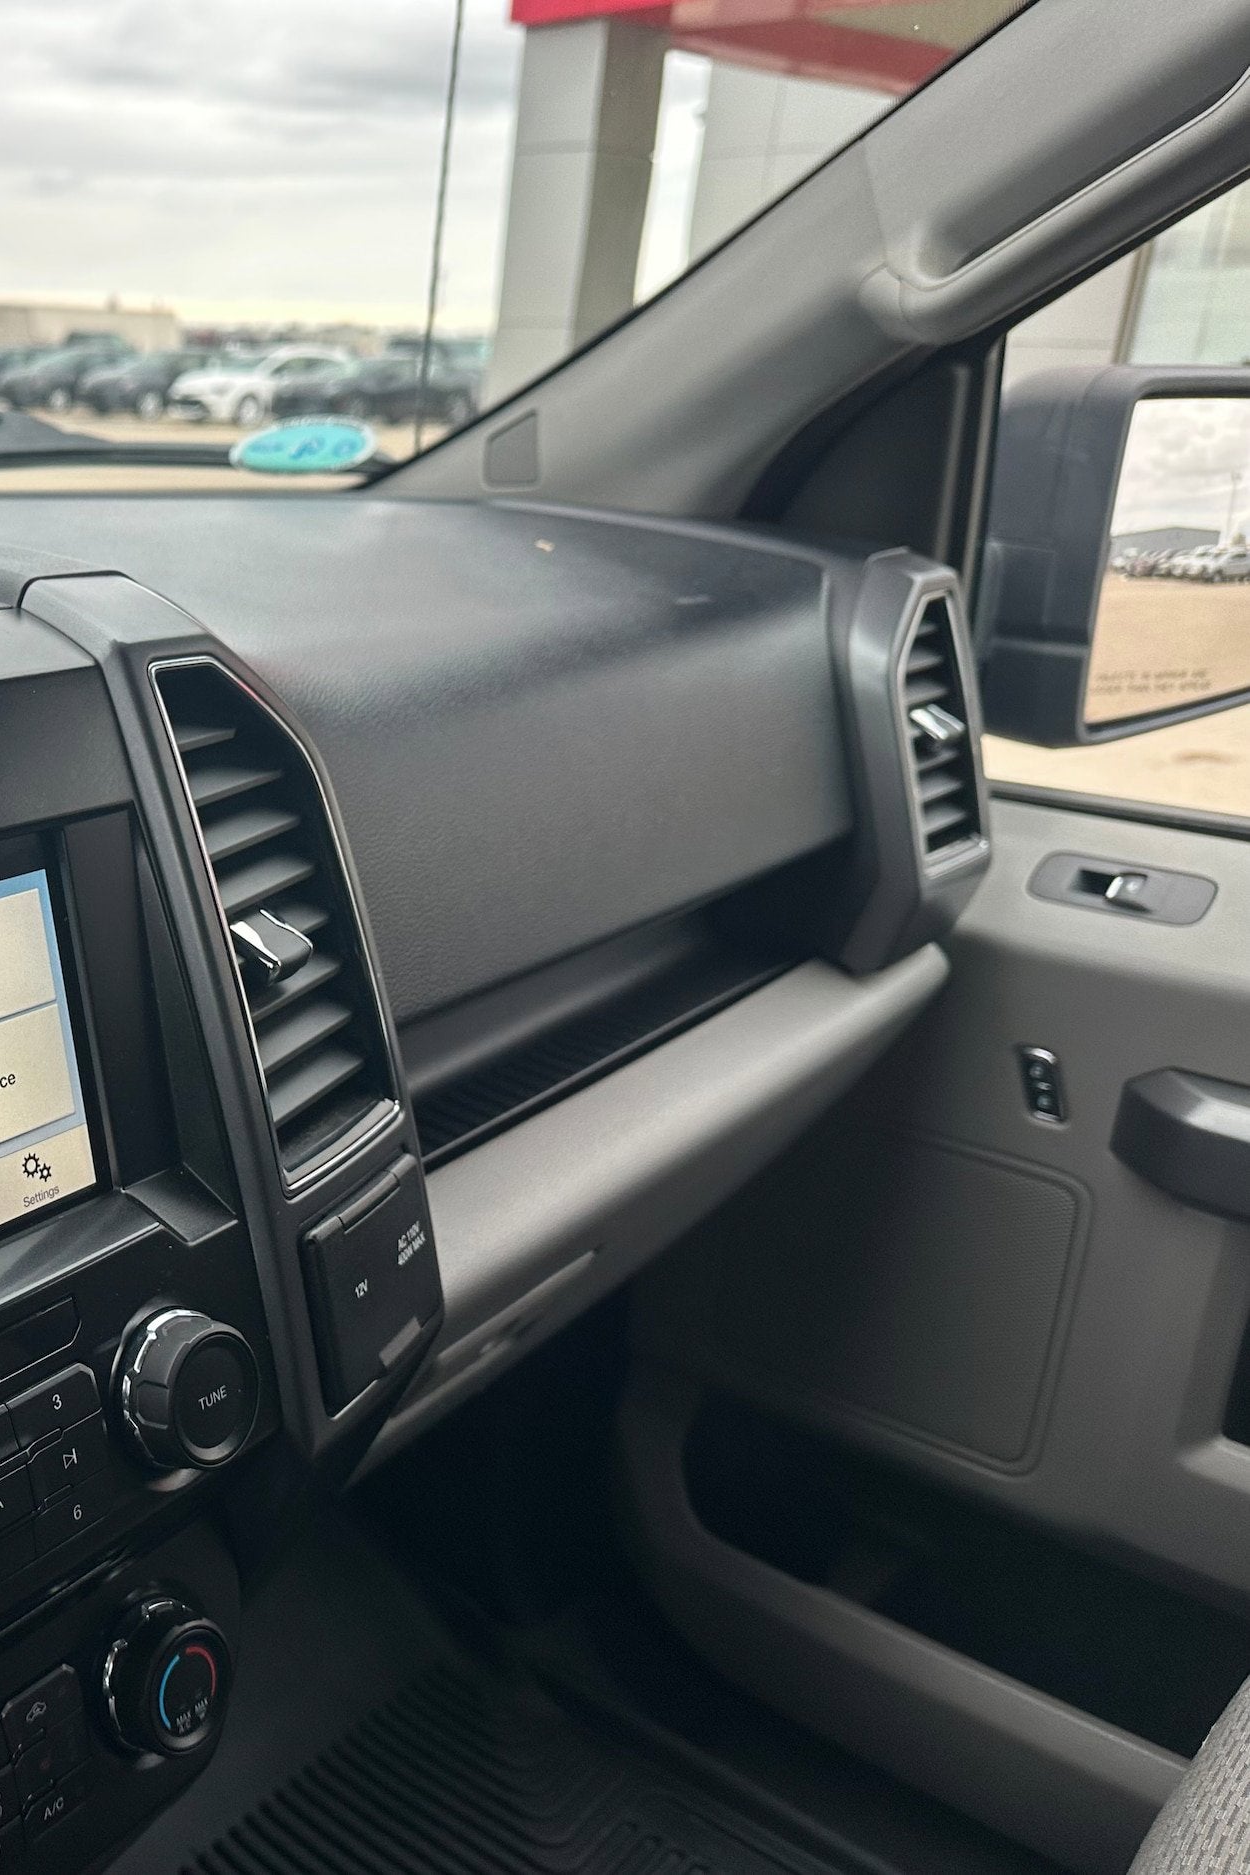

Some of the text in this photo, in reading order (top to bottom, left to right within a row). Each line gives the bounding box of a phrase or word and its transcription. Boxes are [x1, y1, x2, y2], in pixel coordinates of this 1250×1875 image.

[23, 1185, 60, 1208] Settings
[354, 1278, 368, 1298] 12V
[52, 1394, 63, 1410] 3
[198, 1385, 227, 1410] TUNE
[72, 1504, 82, 1521] 6
